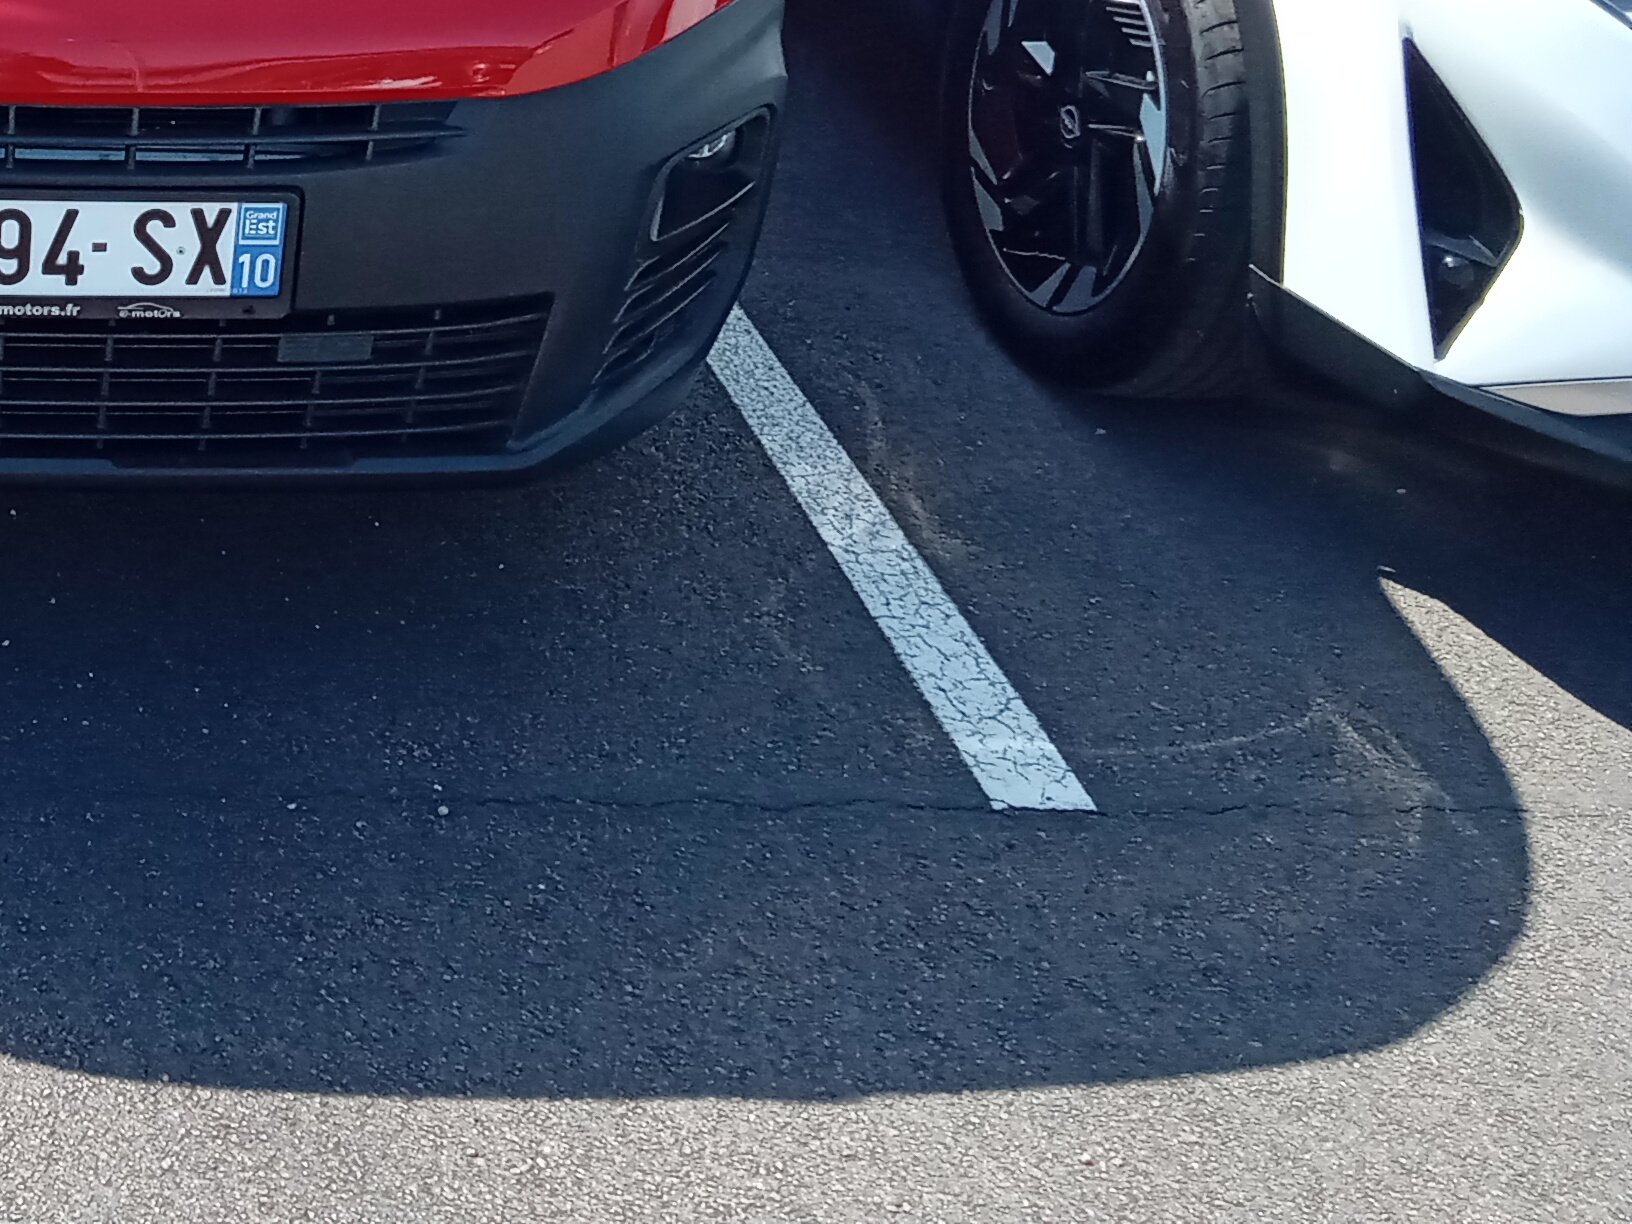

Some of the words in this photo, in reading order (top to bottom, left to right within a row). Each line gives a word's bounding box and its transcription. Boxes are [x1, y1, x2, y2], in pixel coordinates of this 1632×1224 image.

[245, 210, 278, 220] Grand
[244, 219, 276, 235] Est
[238, 253, 276, 288] 10
